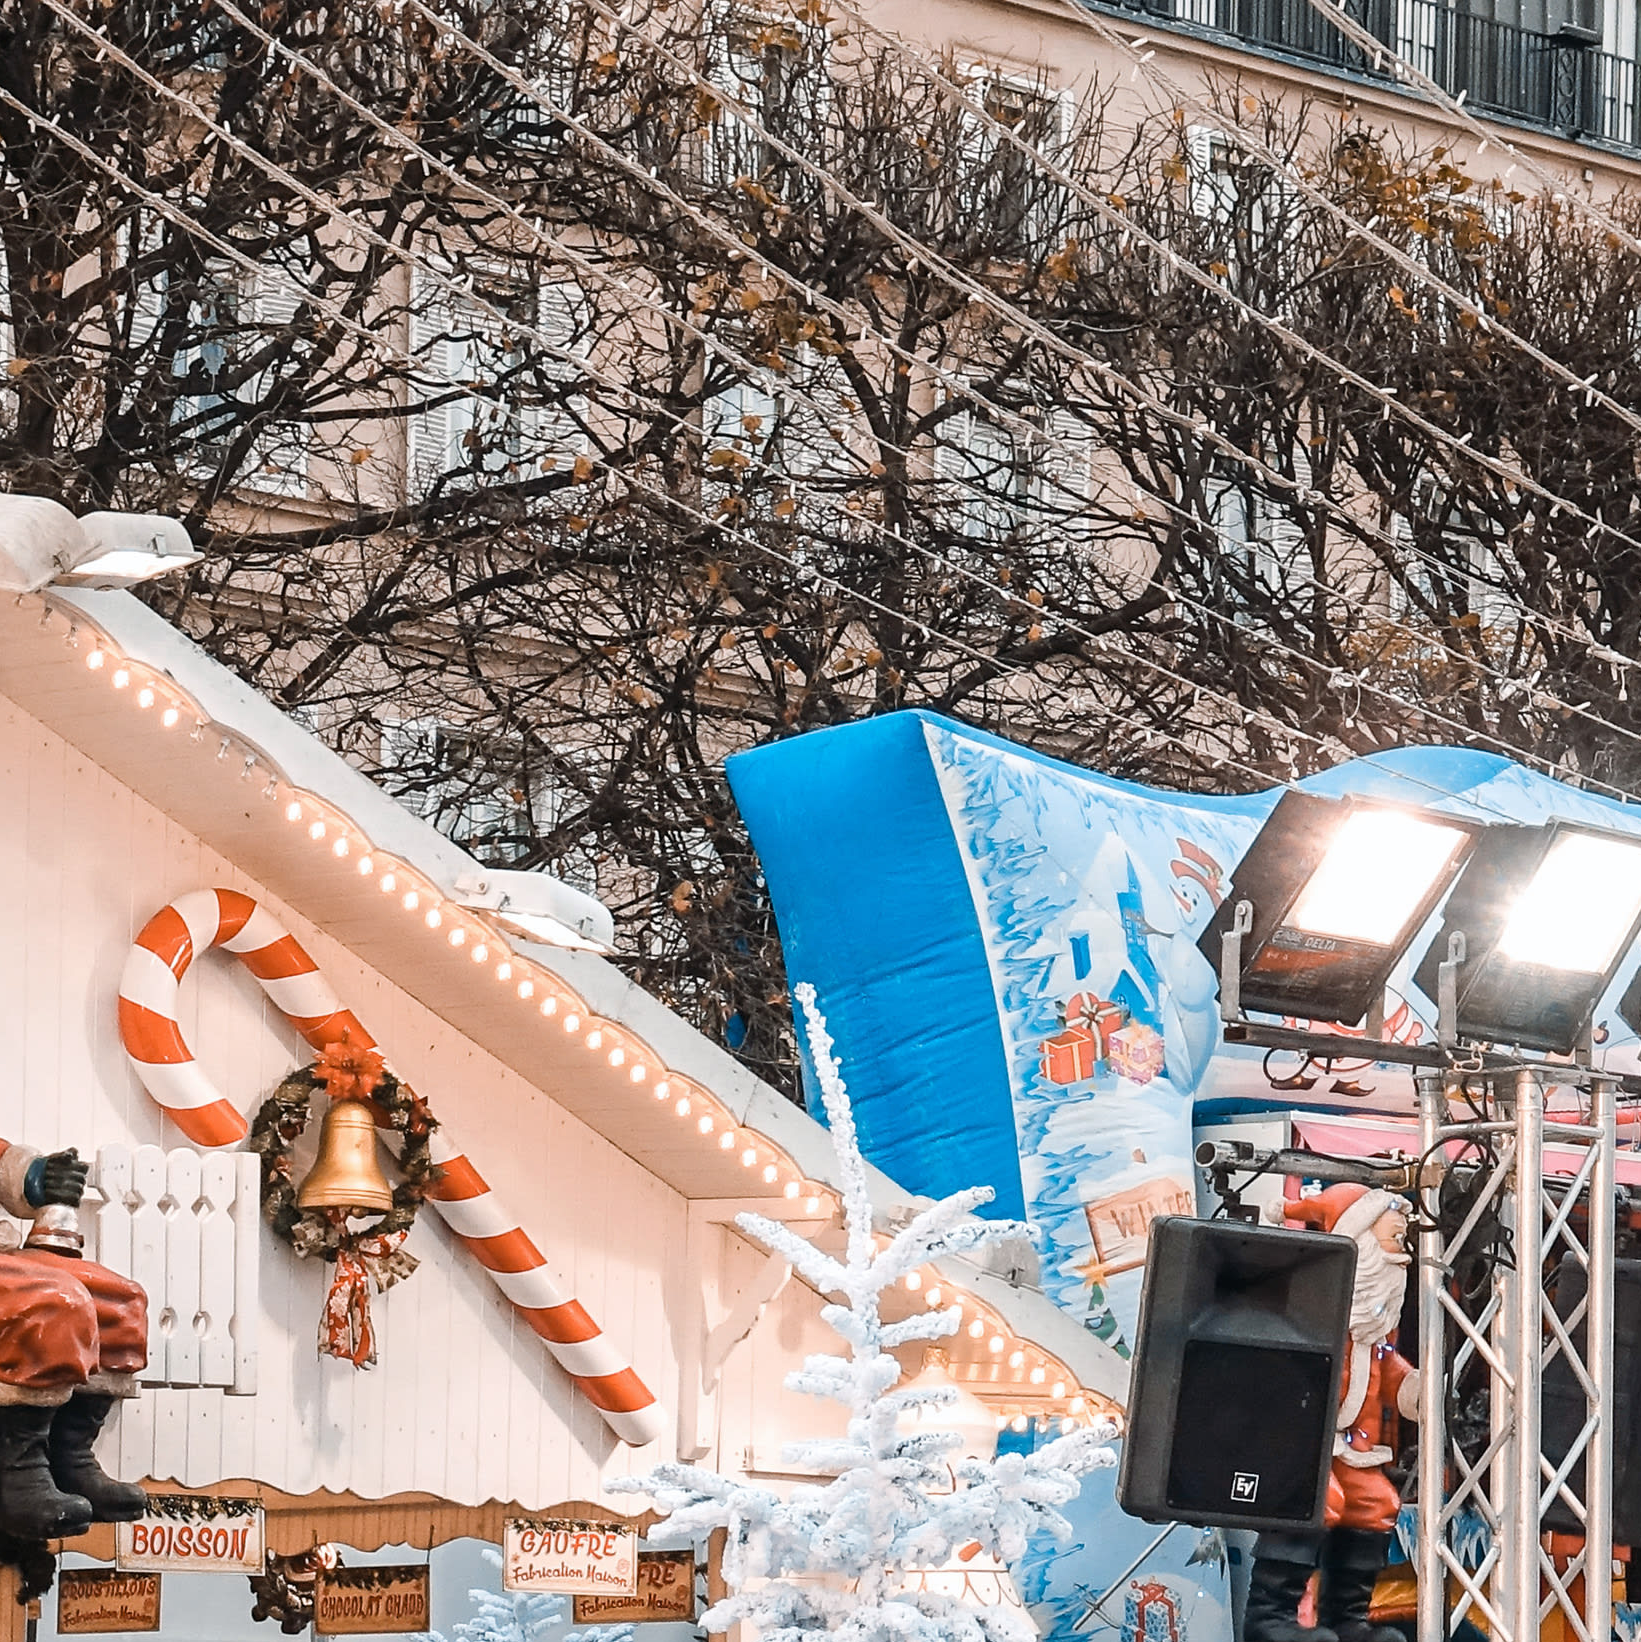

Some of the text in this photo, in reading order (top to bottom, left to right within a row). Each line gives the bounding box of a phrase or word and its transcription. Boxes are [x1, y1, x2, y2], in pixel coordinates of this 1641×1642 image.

[1305, 937, 1337, 951] DELTA
[132, 1524, 248, 1560] BOISSON
[521, 1531, 617, 1559] GAUFRE
[513, 1562, 627, 1587] Fabrication Maison
[637, 1561, 676, 1589] FRE
[580, 1592, 686, 1616] Fabrication Maison
